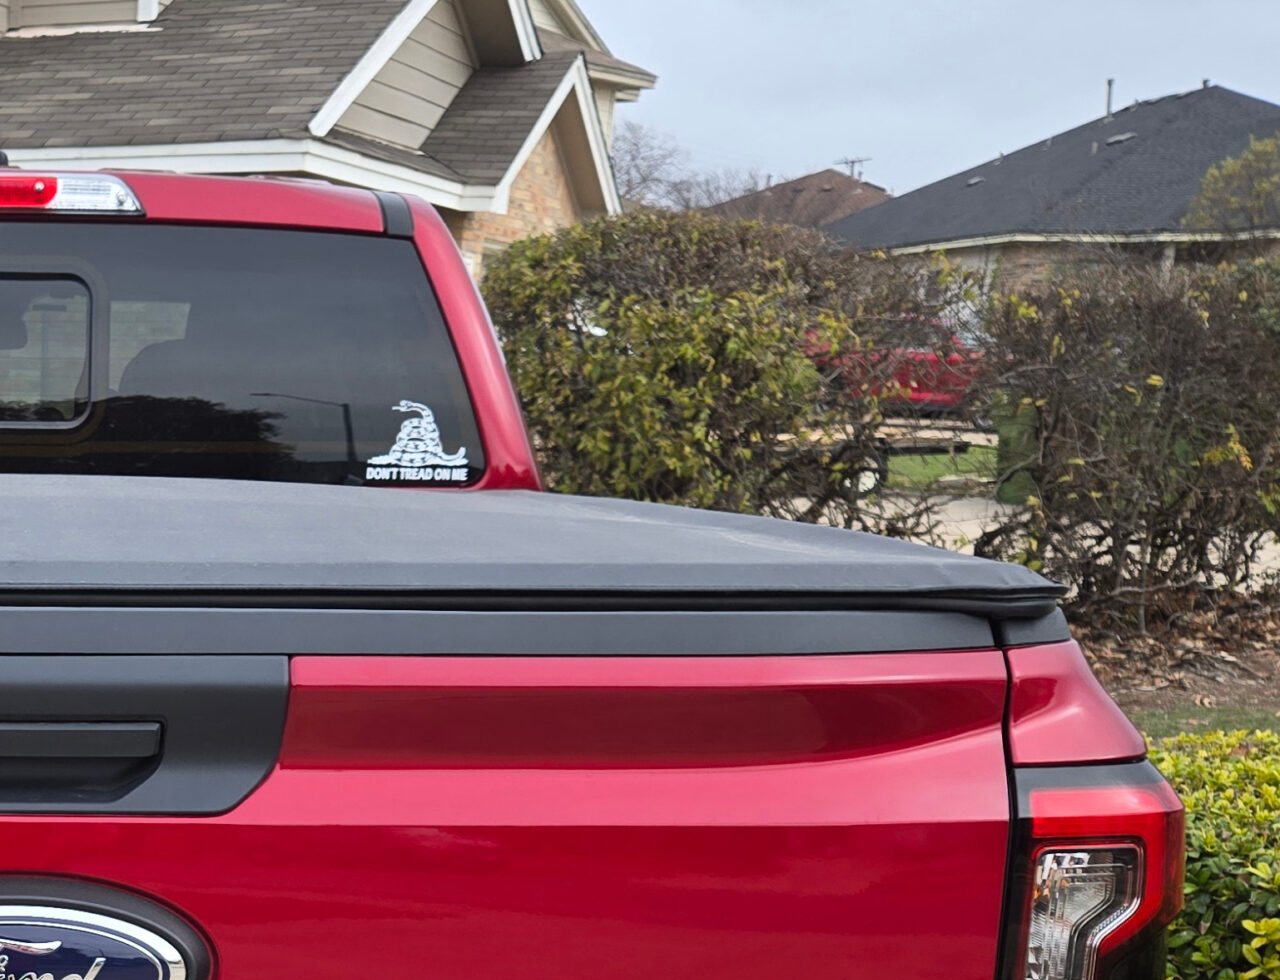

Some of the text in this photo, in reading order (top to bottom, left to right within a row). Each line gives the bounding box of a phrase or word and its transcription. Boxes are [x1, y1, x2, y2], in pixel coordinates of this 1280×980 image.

[366, 467, 468, 480] DON'T TREAD ON ME
